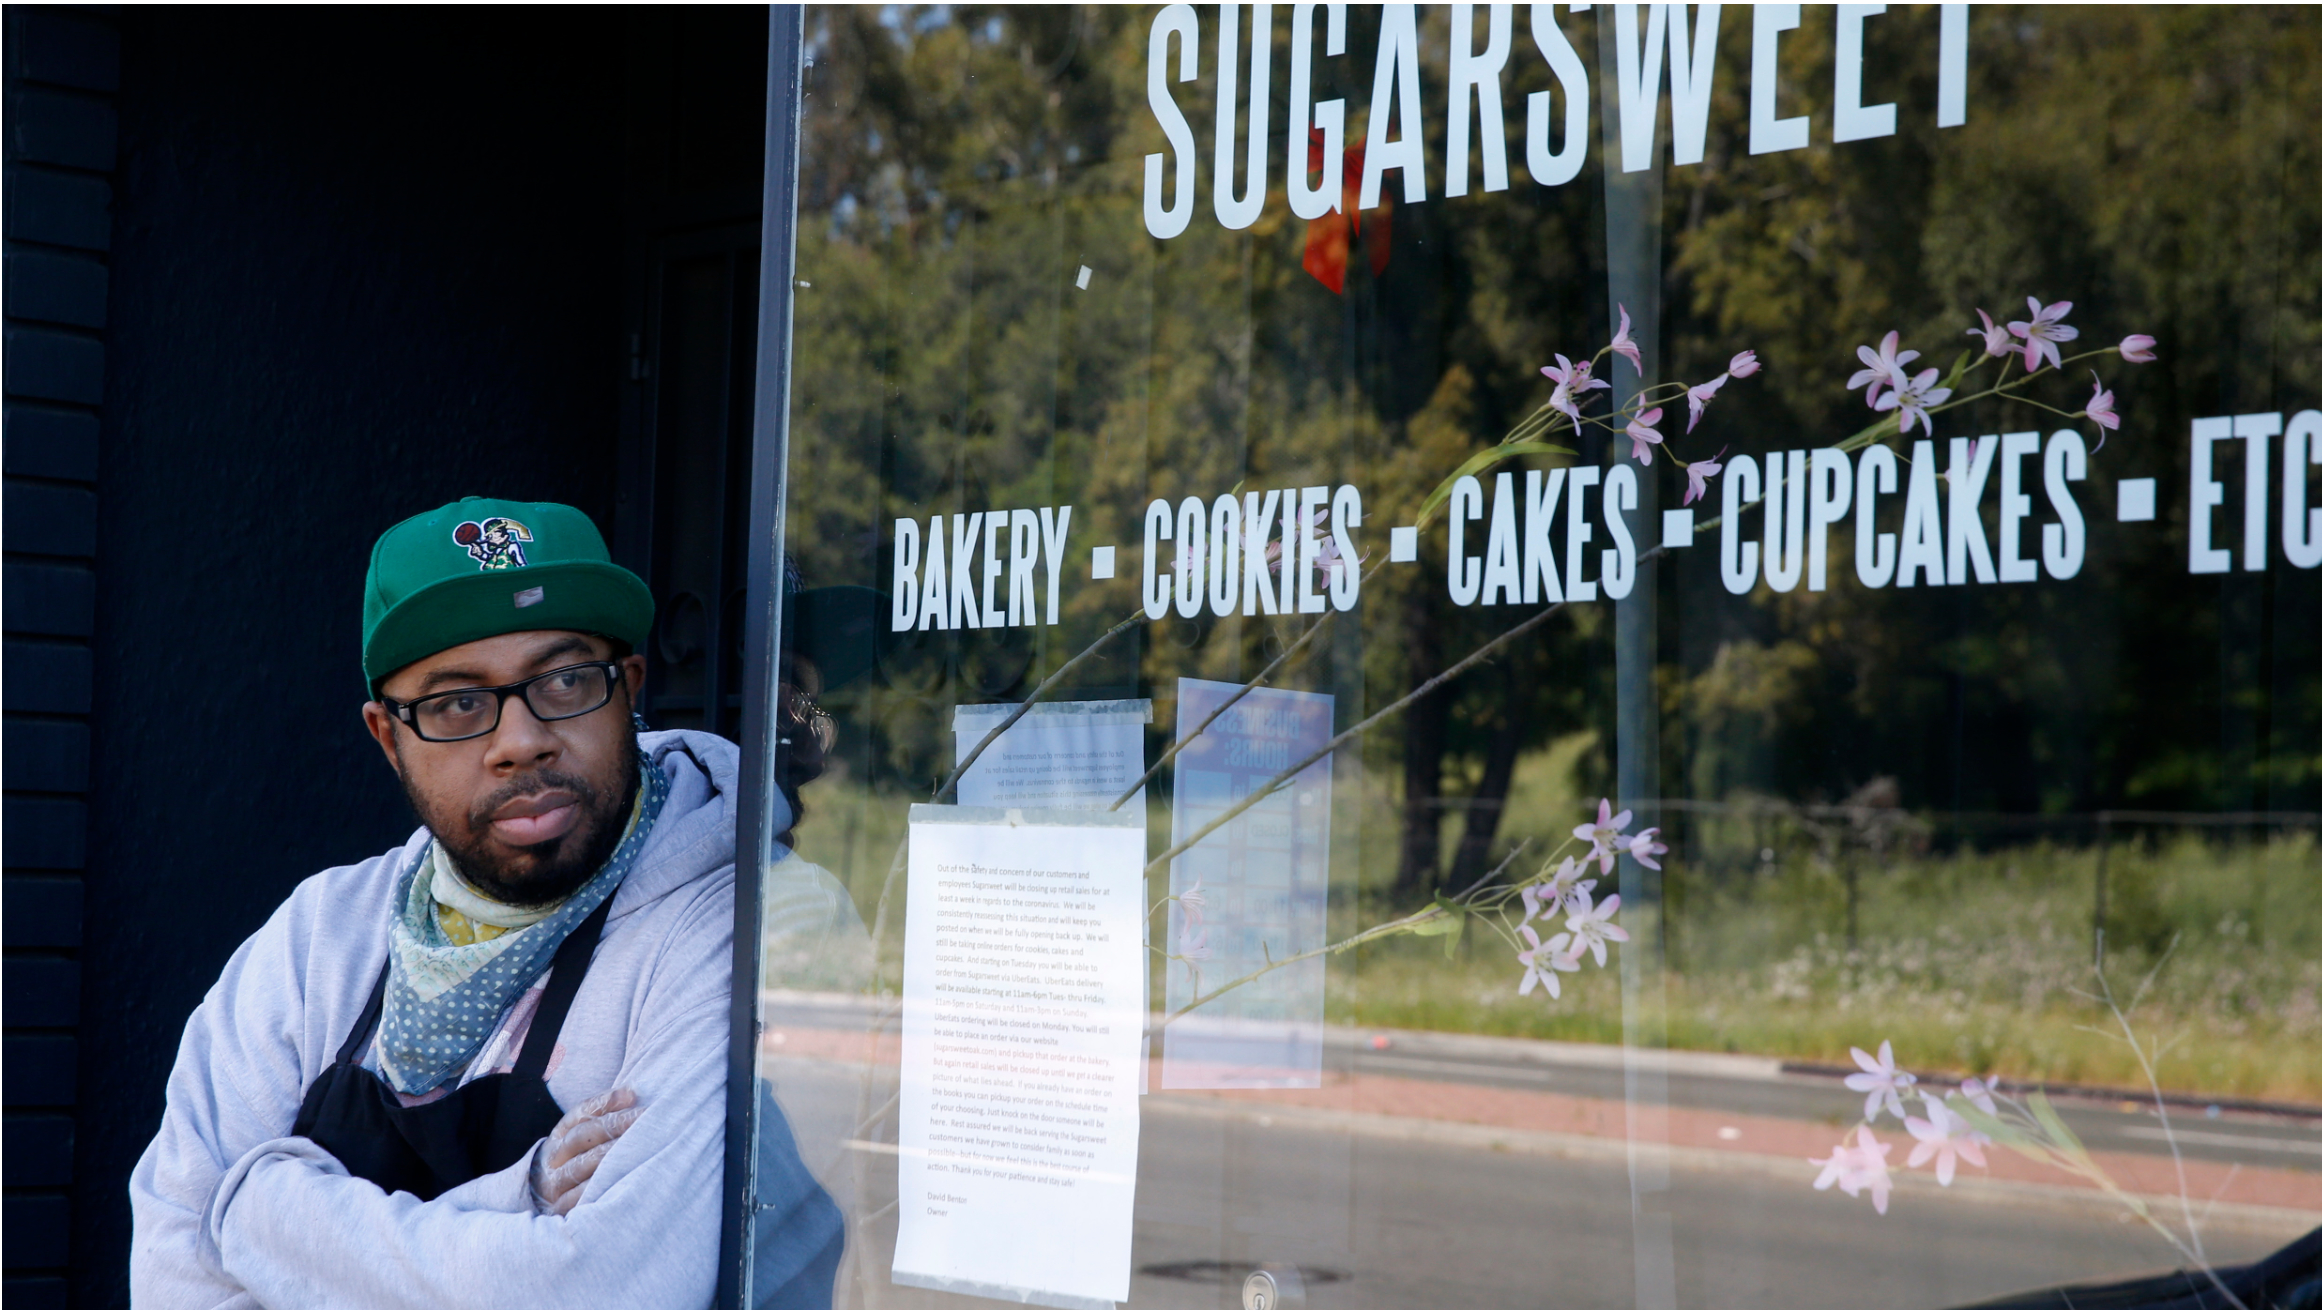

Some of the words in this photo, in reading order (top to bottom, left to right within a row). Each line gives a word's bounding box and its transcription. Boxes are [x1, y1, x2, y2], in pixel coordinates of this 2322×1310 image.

[891, 505, 1072, 632] BAKERY
[1142, 484, 1361, 620] COOKIES
[1447, 464, 1638, 607] CAKES
[1720, 428, 2087, 595] CUPCAKES
[1046, 869, 1077, 878] customers
[938, 879, 971, 890] employees
[972, 880, 1002, 891] Sugarsweet
[1004, 882, 1017, 891] will
[1027, 883, 1048, 894] closing
[1058, 885, 1074, 893] retail
[1076, 886, 1090, 894] sales
[938, 894, 953, 902] least
[960, 895, 975, 904] week
[1075, 901, 1086, 910] will
[937, 909, 973, 921] consistently
[1006, 912, 1018, 921] this
[1020, 913, 1047, 923] situation
[1060, 916, 1071, 924] will
[1072, 916, 1087, 927] keep
[936, 924, 958, 933] posted
[968, 925, 984, 934] when
[1014, 928, 1029, 939] fully
[1031, 930, 1054, 940] opening
[1055, 930, 1071, 939] back
[1098, 933, 1109, 942] will
[958, 939, 976, 951] taking
[994, 942, 1013, 951] orders
[1025, 944, 1050, 956] cookies,
[1051, 946, 1069, 955] cakes
[935, 954, 964, 964] cupcakes.
[980, 956, 1000, 967] starting
[1011, 958, 1036, 970] Tuesday
[1051, 961, 1063, 969] will
[1074, 962, 1089, 971] able
[935, 968, 953, 977] order
[953, 969, 967, 978] from
[968, 970, 1000, 981] Sugarsweet
[1011, 973, 1041, 983] UberEats.
[1045, 975, 1075, 985] UberEats
[1076, 978, 1103, 990] delivery
[935, 982, 947, 991] will
[955, 984, 981, 994] available
[982, 986, 1004, 998] starting
[1068, 993, 1082, 1002] thru
[975, 1000, 1001, 1012] Saturday
[1063, 1007, 1088, 1019] Sunday.
[934, 1012, 960, 1022] UberEats
[961, 1015, 986, 1026] ordering
[987, 1016, 998, 1025] will
[1009, 1018, 1030, 1027] closed
[1042, 1021, 1071, 1033] Monday.
[1086, 1024, 1098, 1033] will
[942, 1028, 954, 1036] able
[964, 1029, 980, 1040] place
[990, 1032, 1008, 1041] order
[1033, 1036, 1058, 1045] website
[1013, 1049, 1034, 1060] pickup
[1035, 1050, 1049, 1059] that
[1051, 1052, 1067, 1061] order
[945, 1059, 961, 1069] again
[962, 1060, 979, 1069] retail
[981, 1062, 995, 1070] sales
[997, 1063, 1008, 1072] will
[1020, 1065, 1040, 1074] closed
[1092, 1071, 1115, 1081] clearer
[932, 1072, 953, 1082] picture
[963, 1075, 979, 1084] what
[993, 1078, 1014, 1088] ahead.
[1037, 1082, 1060, 1094] already
[1061, 1084, 1074, 1093] have
[1084, 1087, 1102, 1096] order
[944, 1088, 962, 1097] books
[990, 1093, 1011, 1104] pickup
[1012, 1097, 1026, 1105] your
[1027, 1097, 1044, 1105] order
[1065, 1100, 1092, 1110] schedule
[1093, 1102, 1108, 1112] time
[940, 1105, 954, 1113] your
[987, 1107, 1000, 1116] Just
[1001, 1109, 1019, 1118] knock
[1041, 1113, 1055, 1122] door
[1056, 1117, 1081, 1125] someone
[1083, 1118, 1095, 1127] will
[929, 1117, 948, 1126] here.
[950, 1119, 965, 1128] Rest
[966, 1123, 991, 1131] assured
[1002, 1125, 1014, 1133] will
[1024, 1127, 1037, 1136] back
[1039, 1130, 1059, 1141] serving
[1071, 1132, 1107, 1143] Sugarsweet
[928, 1132, 964, 1143] customers
[976, 1137, 990, 1146] have
[991, 1141, 1011, 1149] grown
[1020, 1143, 1045, 1152] consider
[1046, 1145, 1063, 1157] family
[1006, 1156, 1019, 1165] feel
[1020, 1157, 1031, 1166] this
[927, 1163, 949, 1172] action.
[951, 1165, 971, 1175] Thank
[992, 1172, 1007, 1180] your
[1008, 1172, 1036, 1183] patience
[927, 1192, 946, 1202] David
[927, 1207, 948, 1217] Owner
